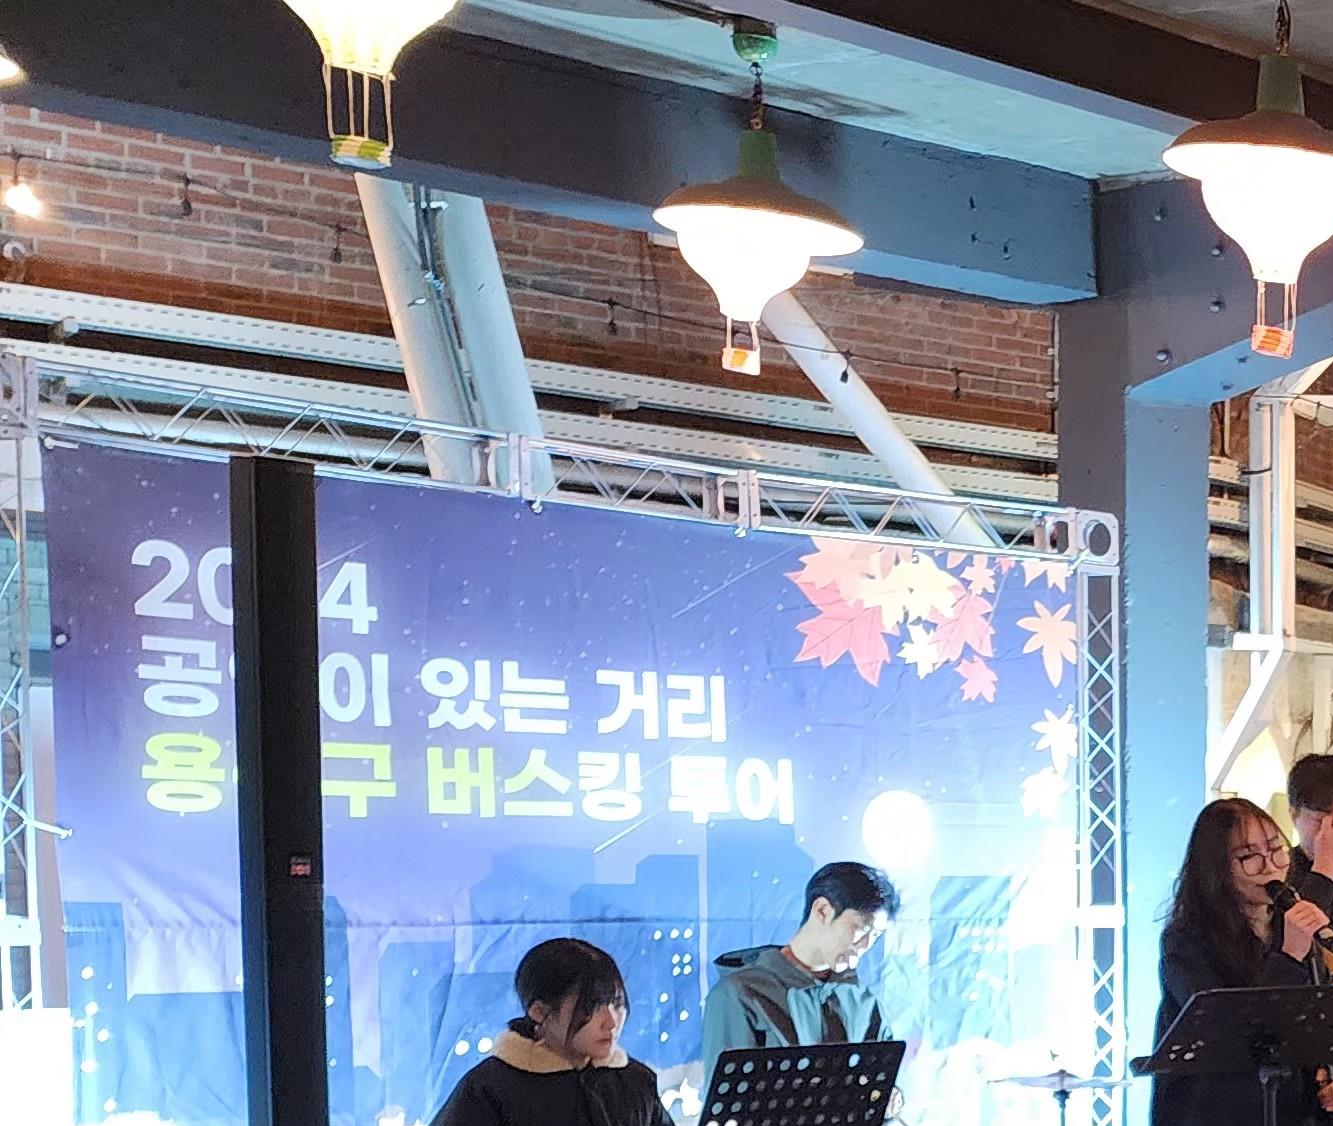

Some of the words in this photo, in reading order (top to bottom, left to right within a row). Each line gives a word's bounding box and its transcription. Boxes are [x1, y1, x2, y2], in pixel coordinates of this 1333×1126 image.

[131, 539, 378, 635] 204
[138, 634, 391, 728] 공이
[420, 657, 570, 735] 있는
[596, 669, 728, 743] 거리
[142, 732, 396, 818] 용구
[426, 746, 644, 822] 버스킹
[667, 755, 795, 825] 투어
